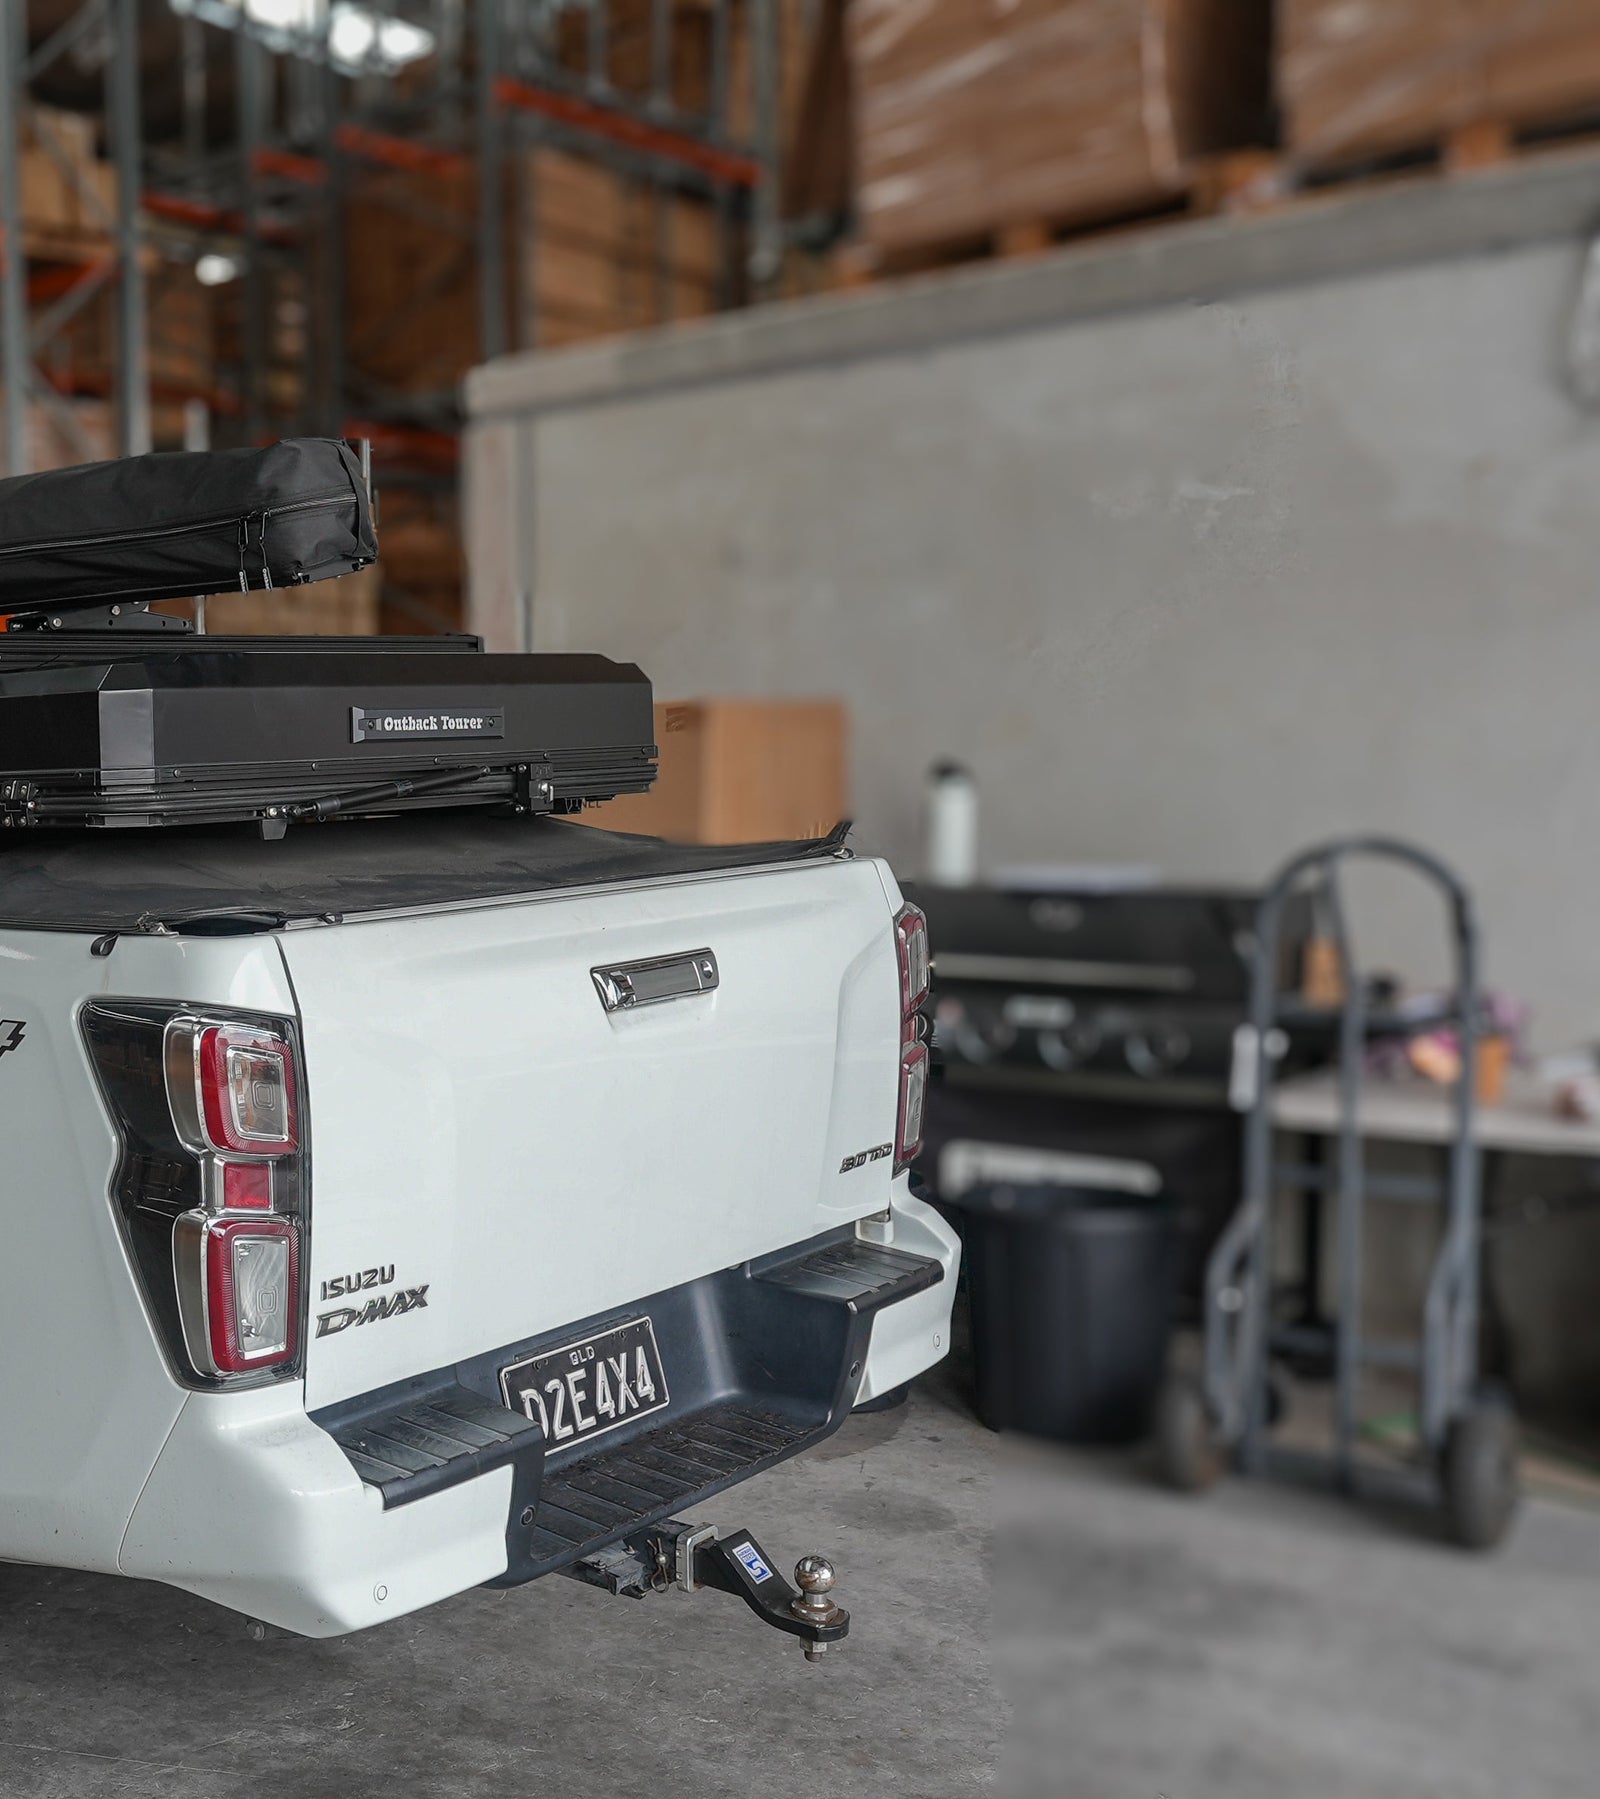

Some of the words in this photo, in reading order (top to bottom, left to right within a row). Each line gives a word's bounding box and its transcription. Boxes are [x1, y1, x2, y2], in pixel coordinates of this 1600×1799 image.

[384, 715, 438, 731] Outback
[441, 715, 484, 730] Tourer
[320, 1264, 395, 1301] ISUZU
[315, 1284, 430, 1339] D-MAX
[569, 1345, 595, 1366] QLD
[519, 1345, 656, 1441] D2E4X4
